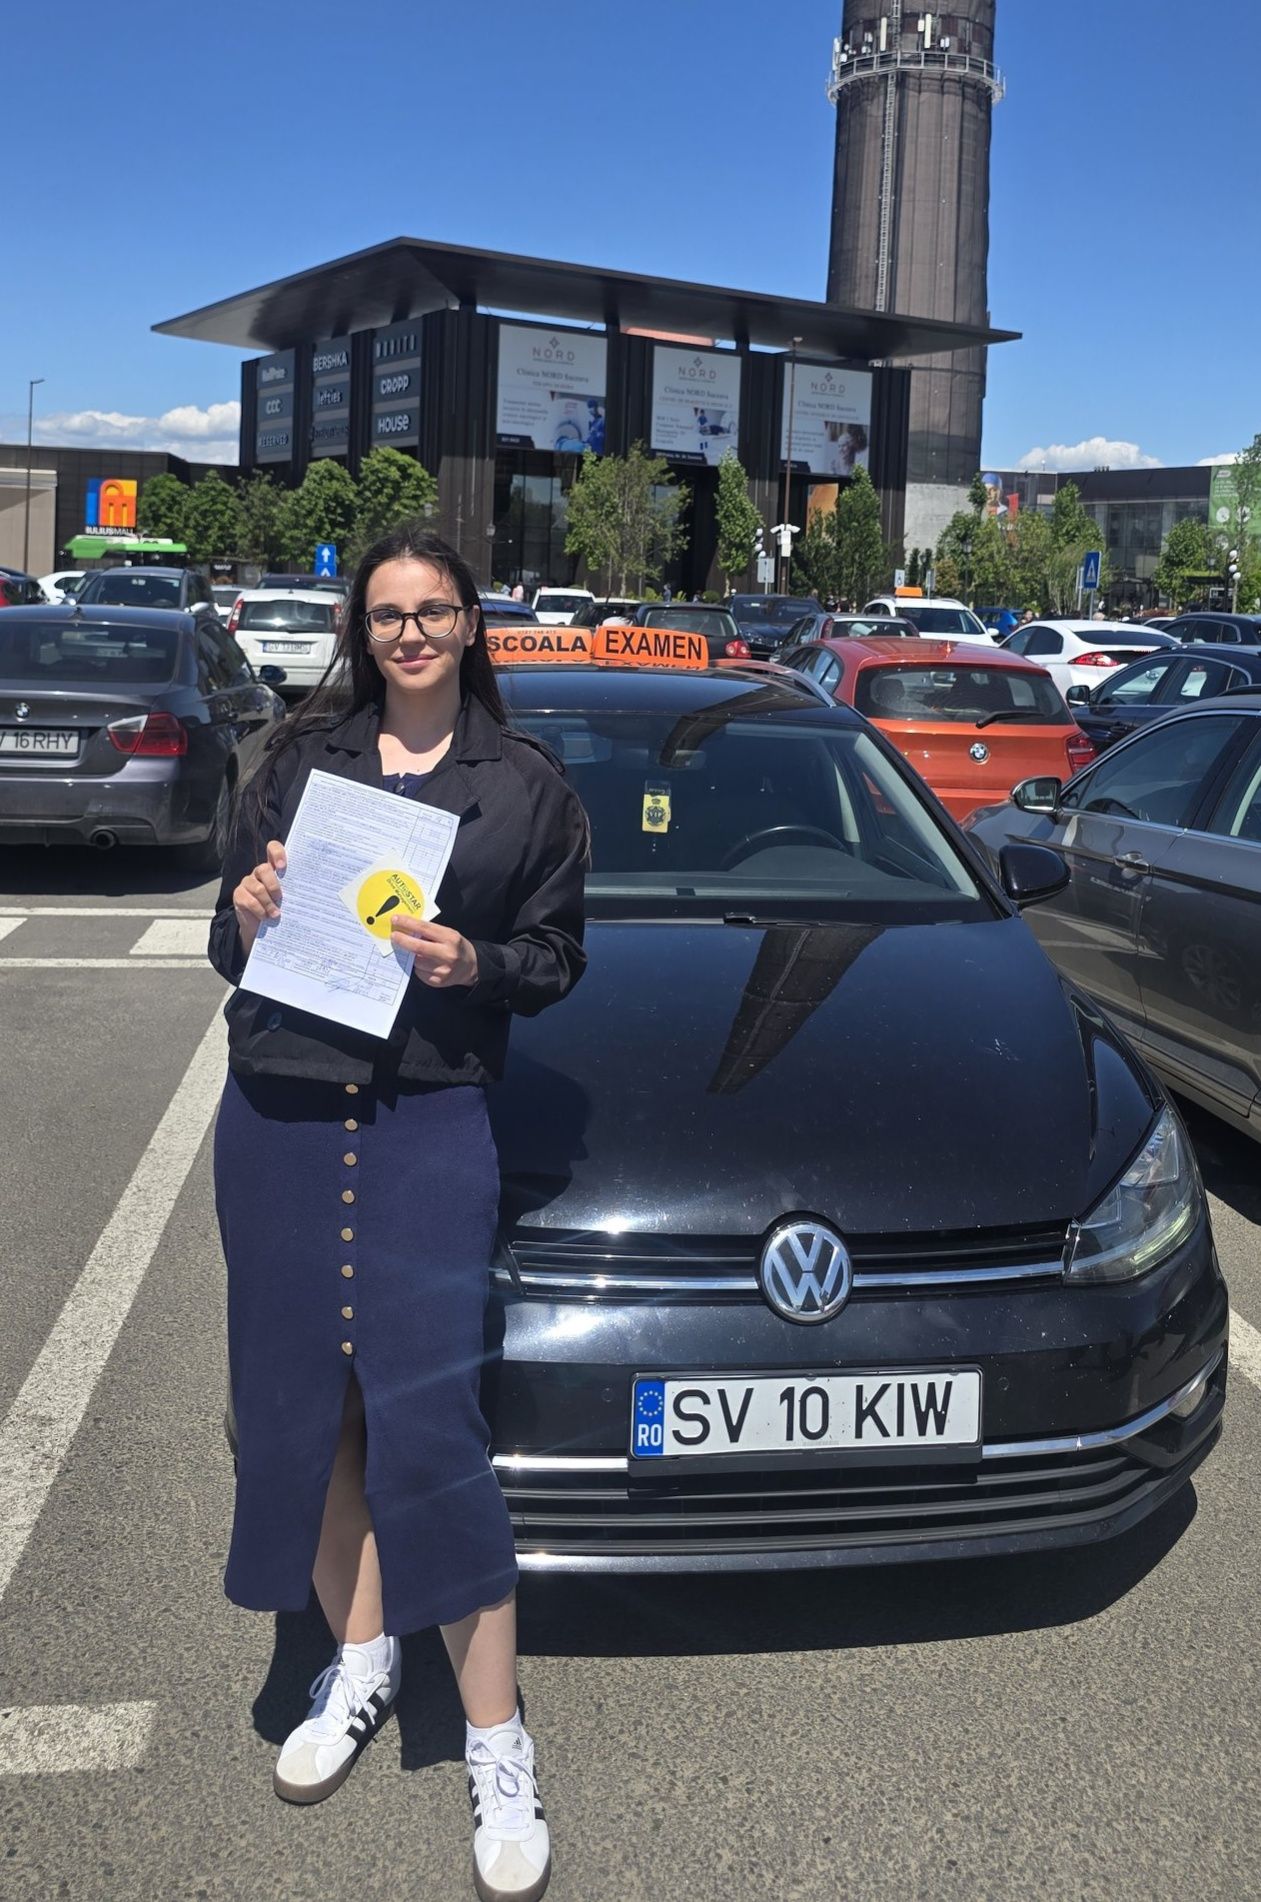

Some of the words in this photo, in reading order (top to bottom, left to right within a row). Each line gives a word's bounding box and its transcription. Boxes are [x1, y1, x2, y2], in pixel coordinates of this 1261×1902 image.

[313, 351, 348, 372] BERSHKA
[532, 347, 575, 361] NORD
[678, 366, 717, 380] NORD
[381, 375, 409, 394] CROPP
[811, 382, 846, 393] NORD
[266, 398, 282, 414] CCC
[487, 635, 587, 652] SCOALA
[605, 630, 702, 660] EXAMEN
[14, 731, 30, 749] 16
[33, 731, 73, 750] RHY
[671, 1386, 754, 1446] SV
[779, 1385, 829, 1441] 10
[855, 1380, 953, 1440] KIW
[637, 1423, 662, 1447] RO
